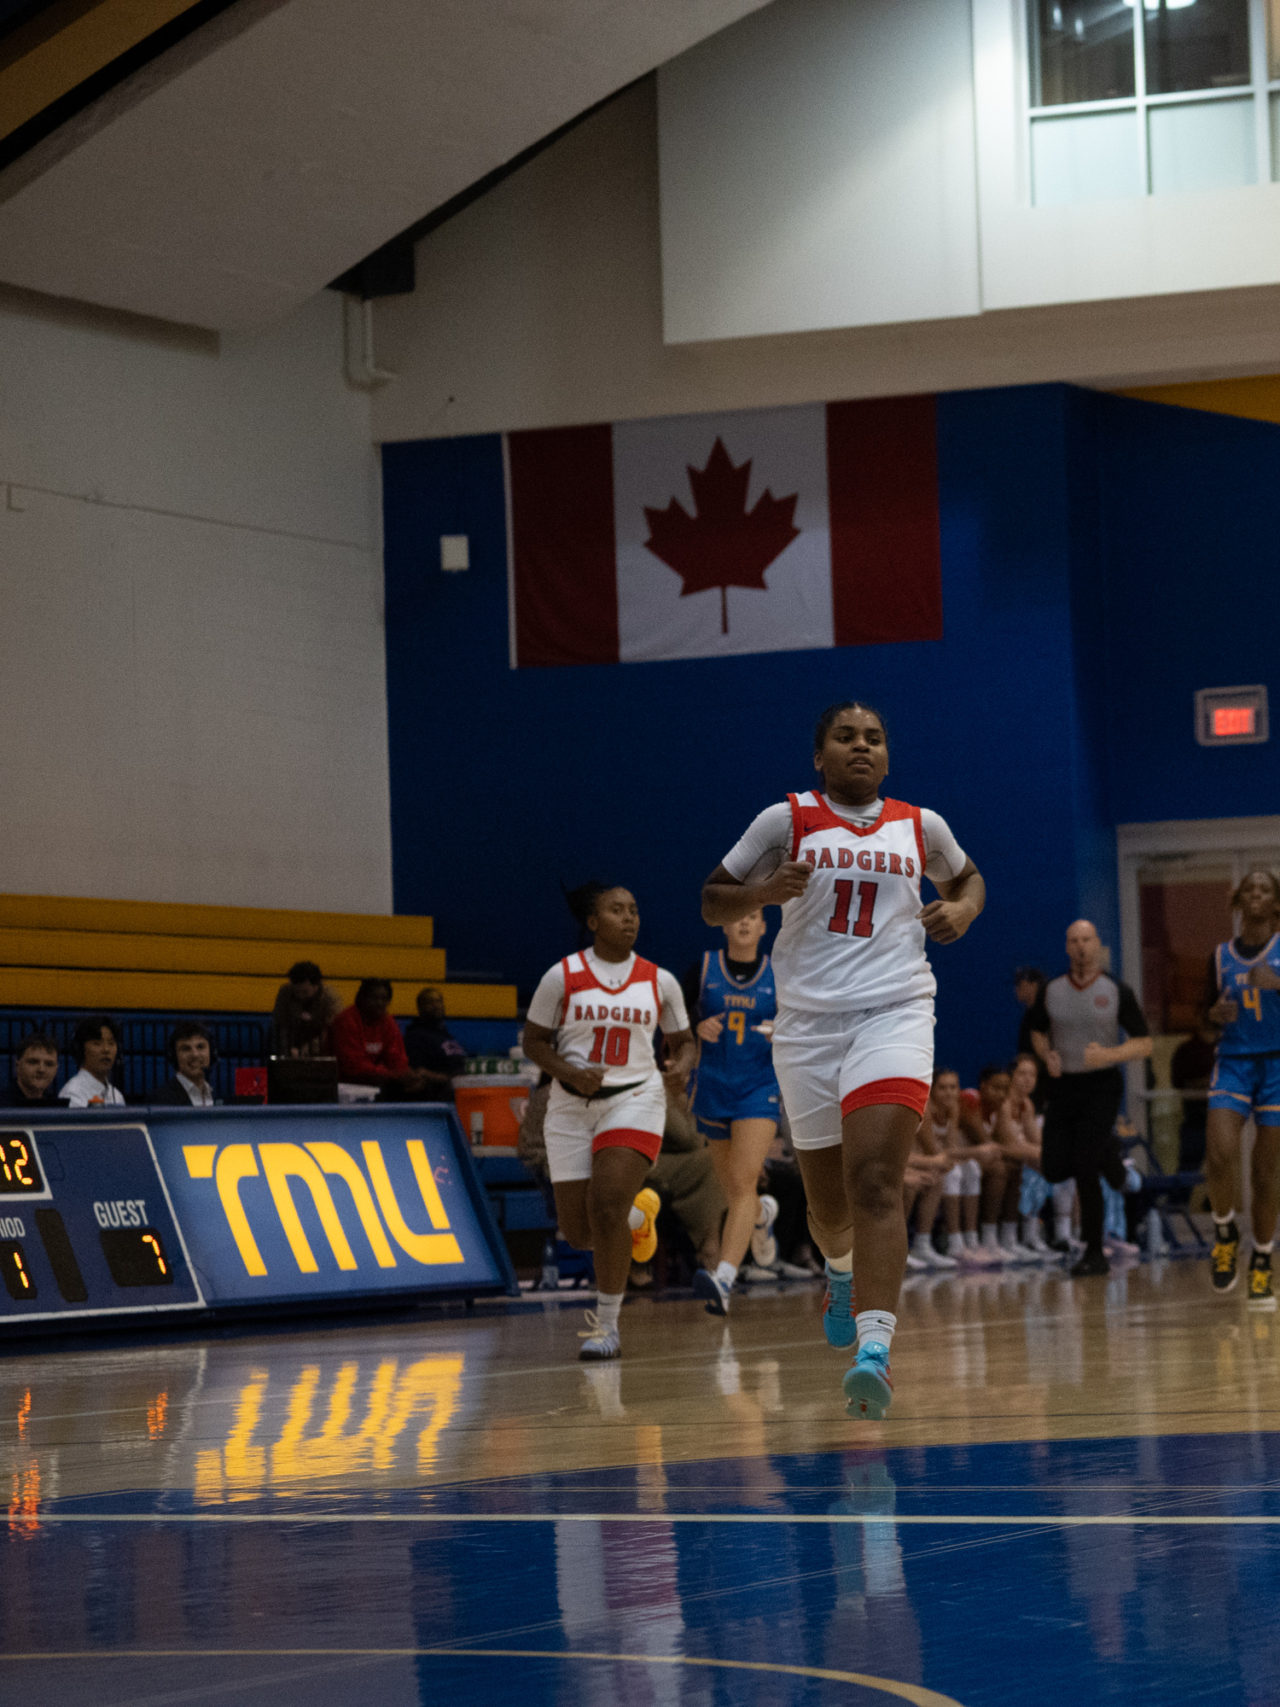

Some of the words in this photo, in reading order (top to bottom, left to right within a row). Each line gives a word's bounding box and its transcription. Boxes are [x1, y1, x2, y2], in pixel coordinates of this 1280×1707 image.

[804, 847, 915, 878] BADGERS
[828, 878, 878, 938] 11
[574, 1005, 652, 1025] BADGERS
[1242, 986, 1263, 1022] 4
[588, 1026, 631, 1067] 10
[728, 1010, 746, 1046] 9
[93, 1200, 149, 1229] GUEST
[181, 1139, 465, 1277] TMU
[13, 1251, 29, 1289] 1
[141, 1234, 167, 1275] 7
